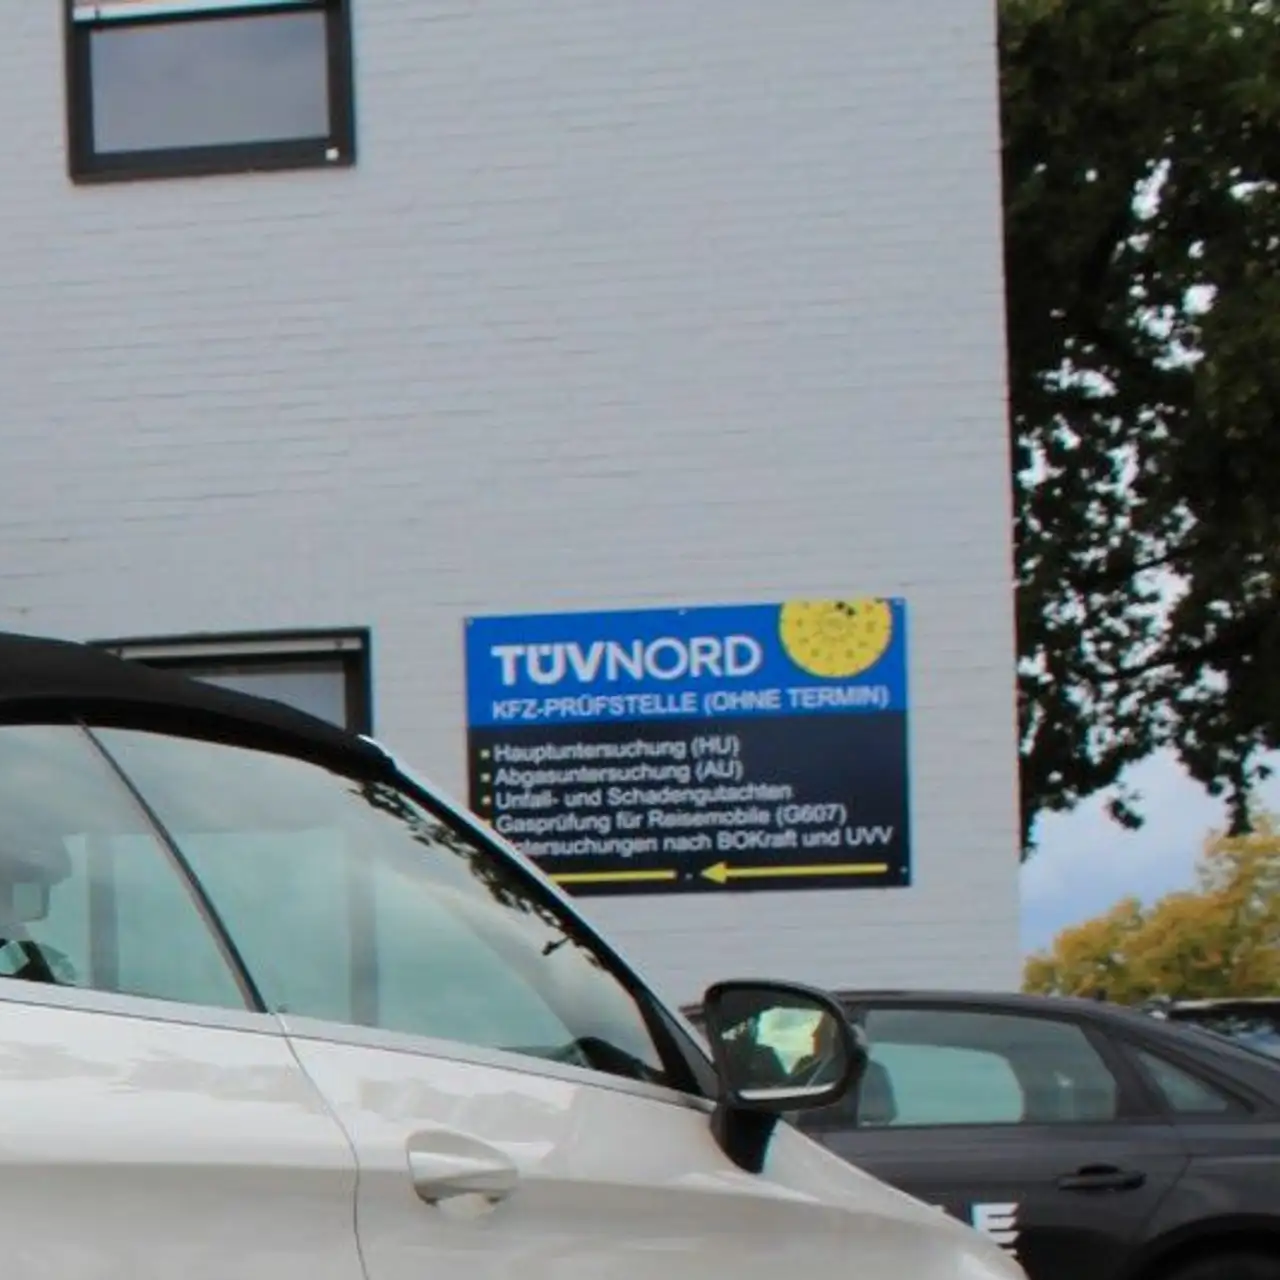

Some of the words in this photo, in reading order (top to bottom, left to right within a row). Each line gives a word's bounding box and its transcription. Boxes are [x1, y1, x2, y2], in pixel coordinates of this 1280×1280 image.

[492, 693, 698, 721] KFZ-PRÜFSTELLE
[704, 688, 782, 716] (OHNE
[787, 684, 890, 709] TERMIN)
[493, 739, 687, 764] Hauptuntersuchung
[691, 735, 740, 759] (HU)
[494, 763, 691, 789] Abgasuntersuchung
[695, 760, 744, 782] (AU)
[495, 791, 559, 811] Unfall-
[565, 790, 601, 808] und
[495, 813, 611, 837] Gasprüfung
[616, 808, 644, 830] für
[647, 805, 770, 829] Reisemobile
[775, 803, 847, 827] (G607)
[511, 832, 658, 858] tersuchungen
[663, 829, 713, 851] nach
[802, 824, 840, 847] und
[844, 825, 894, 847] UVV
